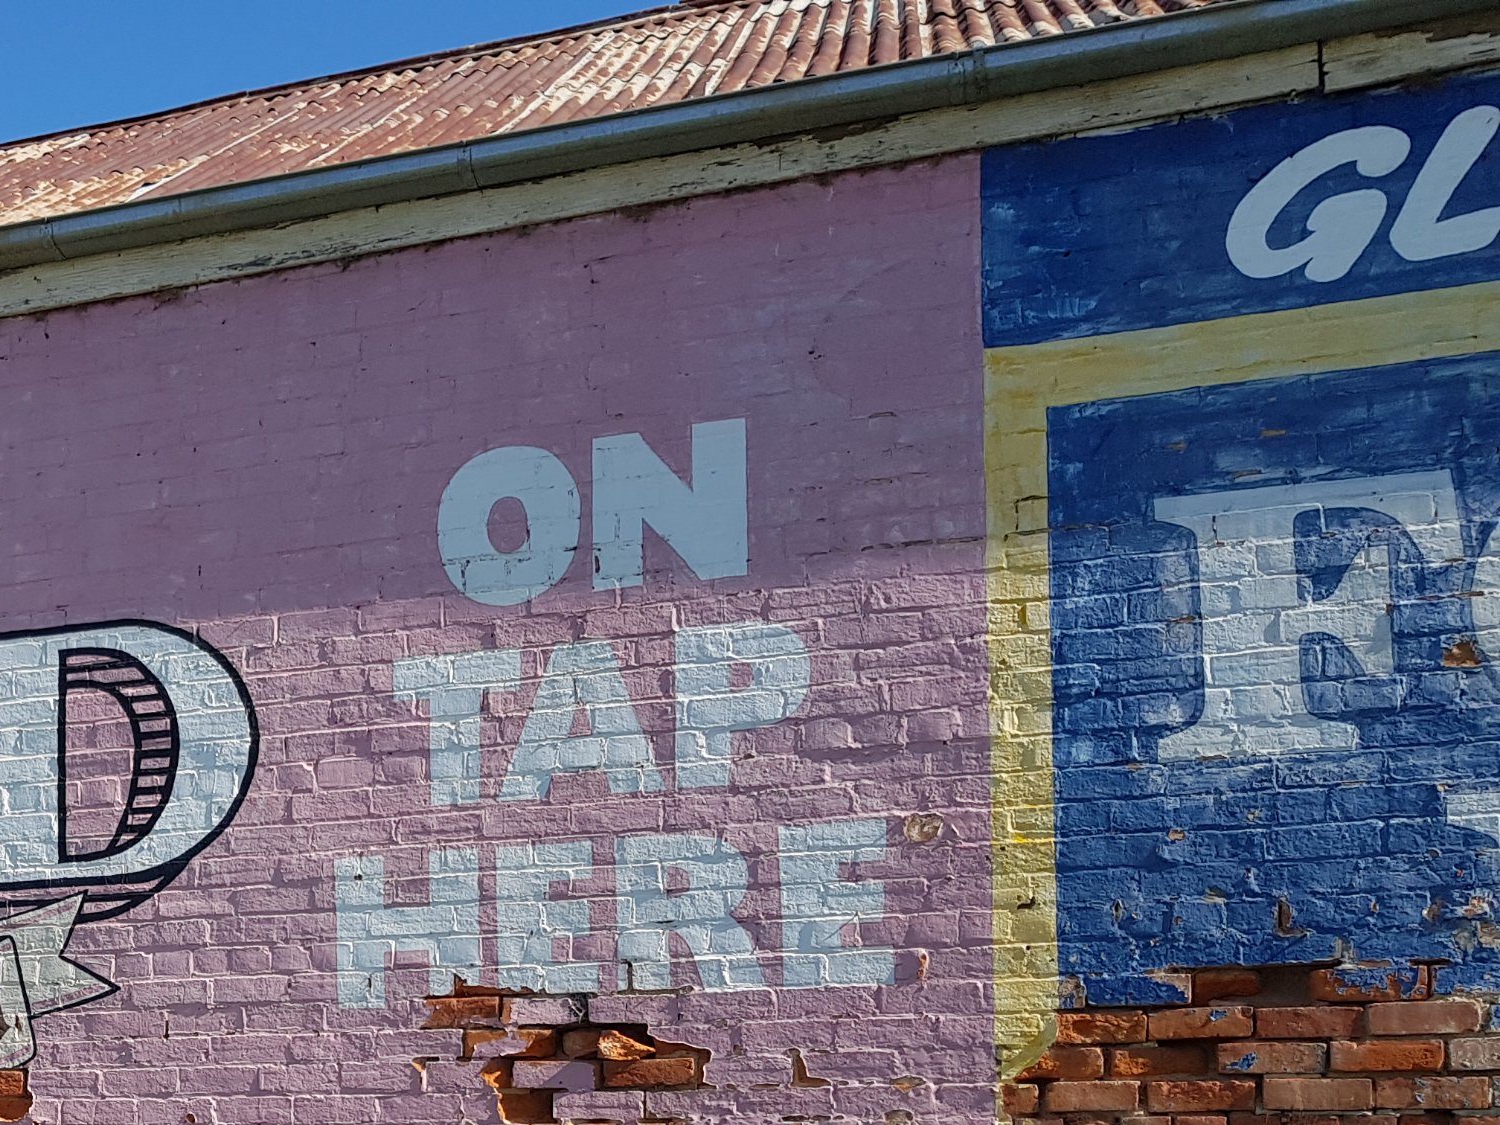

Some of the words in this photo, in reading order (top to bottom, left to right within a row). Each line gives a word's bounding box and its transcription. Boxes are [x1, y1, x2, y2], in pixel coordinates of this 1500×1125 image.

[437, 418, 750, 606] ON
[1153, 467, 1500, 764] F
[393, 622, 812, 806] TAP
[334, 819, 896, 1009] HERE
